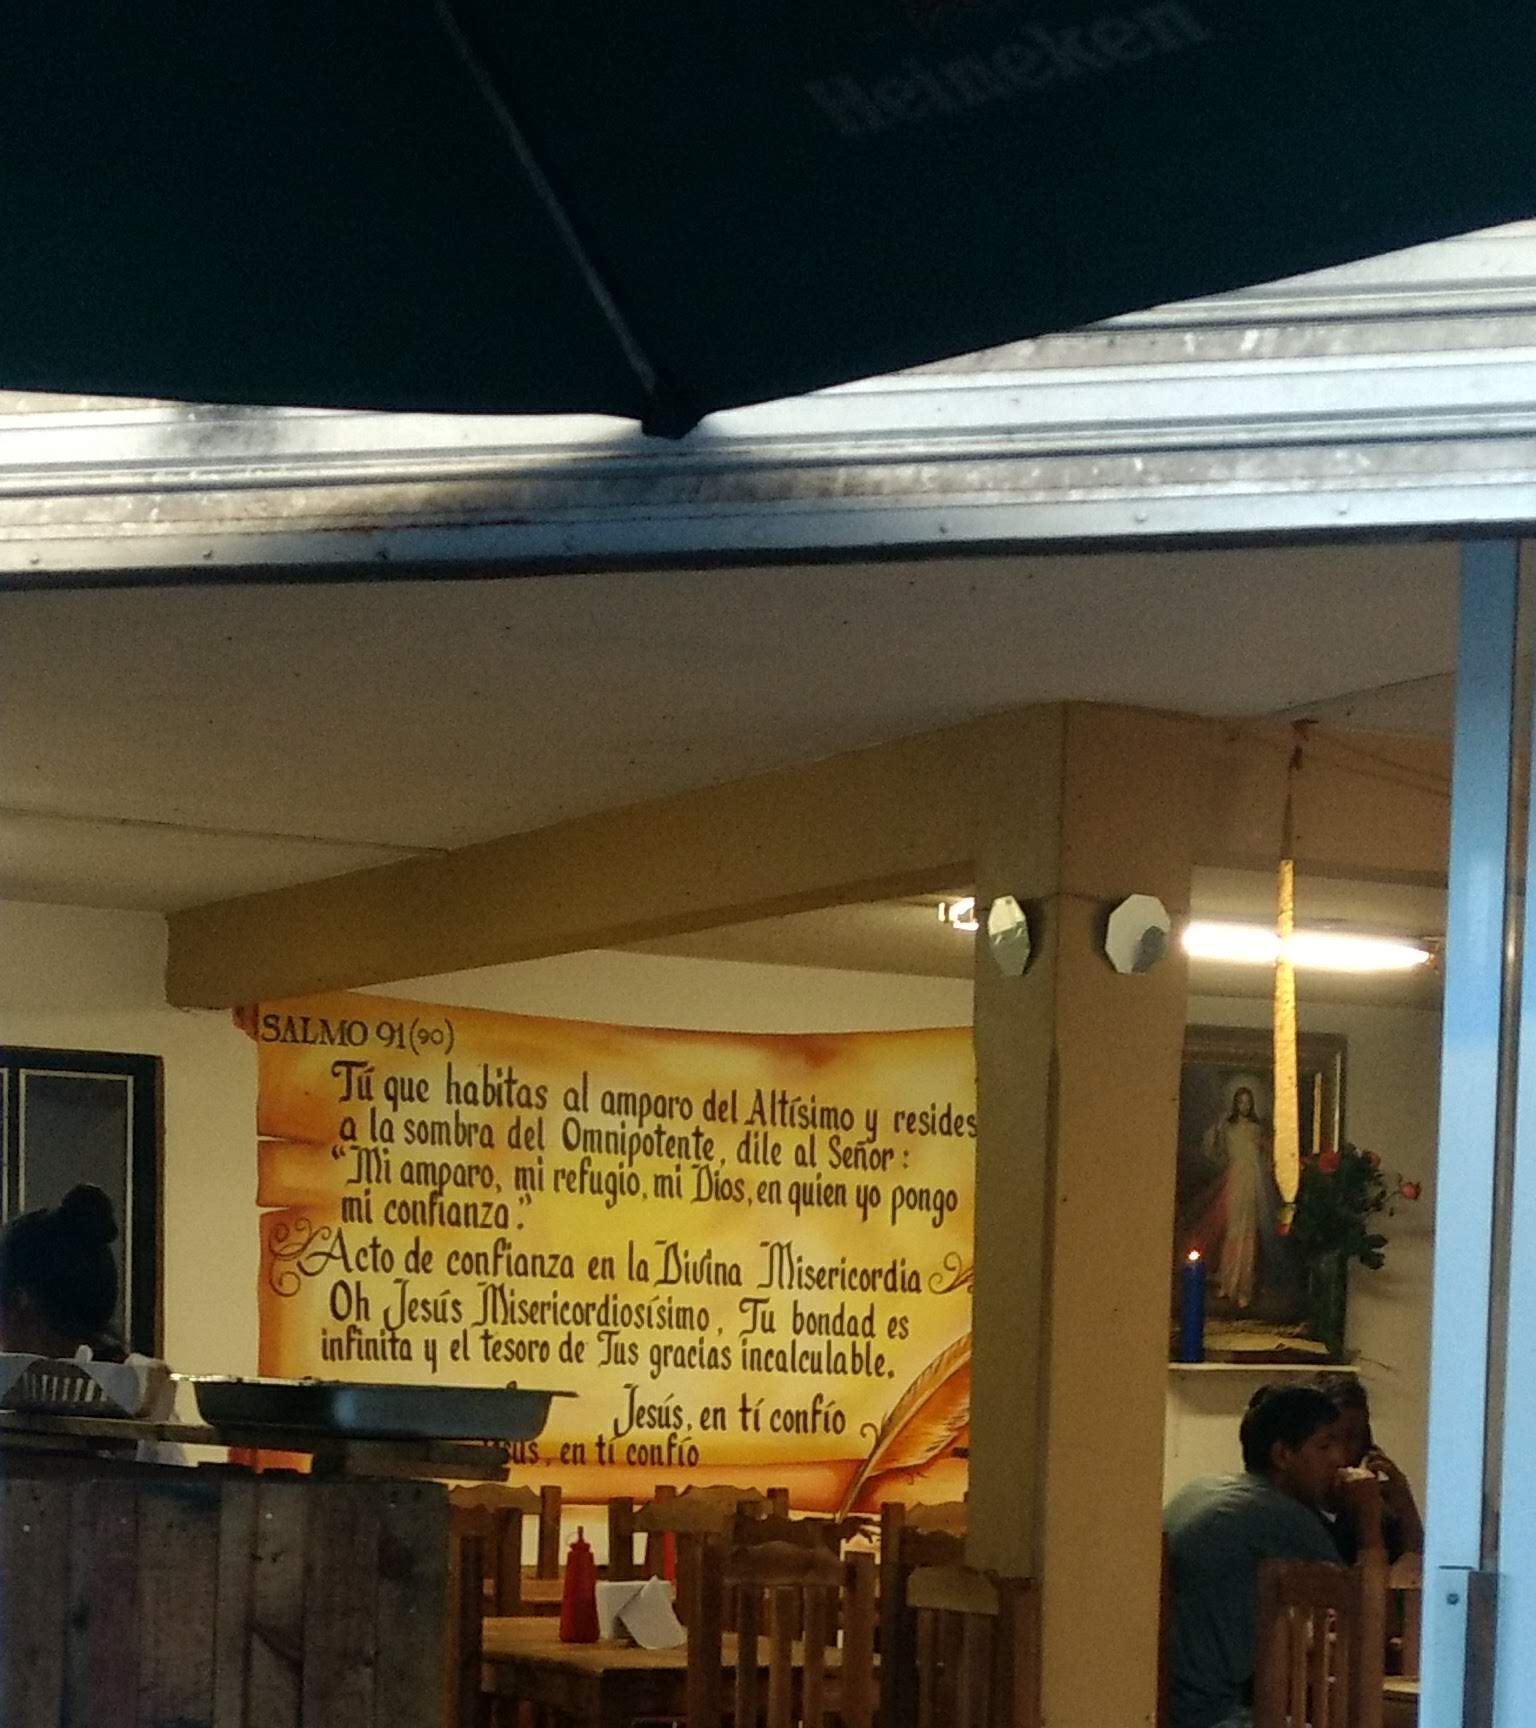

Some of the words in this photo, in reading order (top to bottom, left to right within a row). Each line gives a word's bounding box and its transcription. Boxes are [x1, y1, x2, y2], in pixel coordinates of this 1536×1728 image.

[262, 1013, 368, 1047] SALMO
[375, 1017, 455, 1056] 91(90)
[330, 1060, 376, 1103] Tú
[383, 1075, 430, 1113] que
[446, 1061, 549, 1111] habitas
[563, 1070, 590, 1114] al
[601, 1089, 694, 1129] amparo
[702, 1088, 738, 1125] del
[744, 1088, 855, 1132] Altísimo
[864, 1107, 878, 1144] y
[894, 1102, 978, 1139] resides
[340, 1115, 357, 1141] a
[369, 1106, 394, 1145] la
[404, 1109, 495, 1149] sombra
[507, 1115, 545, 1152] del
[736, 1131, 782, 1167] dile
[794, 1133, 817, 1168] al
[341, 1191, 374, 1225] mi
[400, 1157, 502, 1196] amparo,
[514, 1155, 544, 1192] mi
[653, 1163, 683, 1200] mi
[690, 1163, 753, 1207] Dios,
[757, 1179, 781, 1206] en
[788, 1172, 848, 1217] quien
[855, 1187, 882, 1223] yo
[890, 1184, 959, 1229] pongo
[297, 1226, 395, 1277] Acto
[404, 1235, 434, 1275] de
[446, 1236, 575, 1280] confianza
[587, 1254, 616, 1282] en
[628, 1239, 650, 1283] la
[756, 1240, 923, 1294] Misericordia
[329, 1279, 371, 1323] Oh
[383, 1278, 464, 1332] Jesús
[738, 1296, 776, 1338] Tu
[791, 1299, 877, 1339] bondad
[886, 1314, 910, 1341] es
[321, 1324, 413, 1363] infinita
[423, 1335, 438, 1374] y
[449, 1328, 473, 1363] el
[480, 1329, 551, 1364] tesoro
[558, 1330, 585, 1364] de
[596, 1330, 640, 1368] Tus
[649, 1335, 733, 1380] gracias
[699, 1405, 727, 1433] en
[769, 1392, 847, 1436] confío
[559, 1441, 586, 1466] en
[625, 1432, 701, 1468] confío
